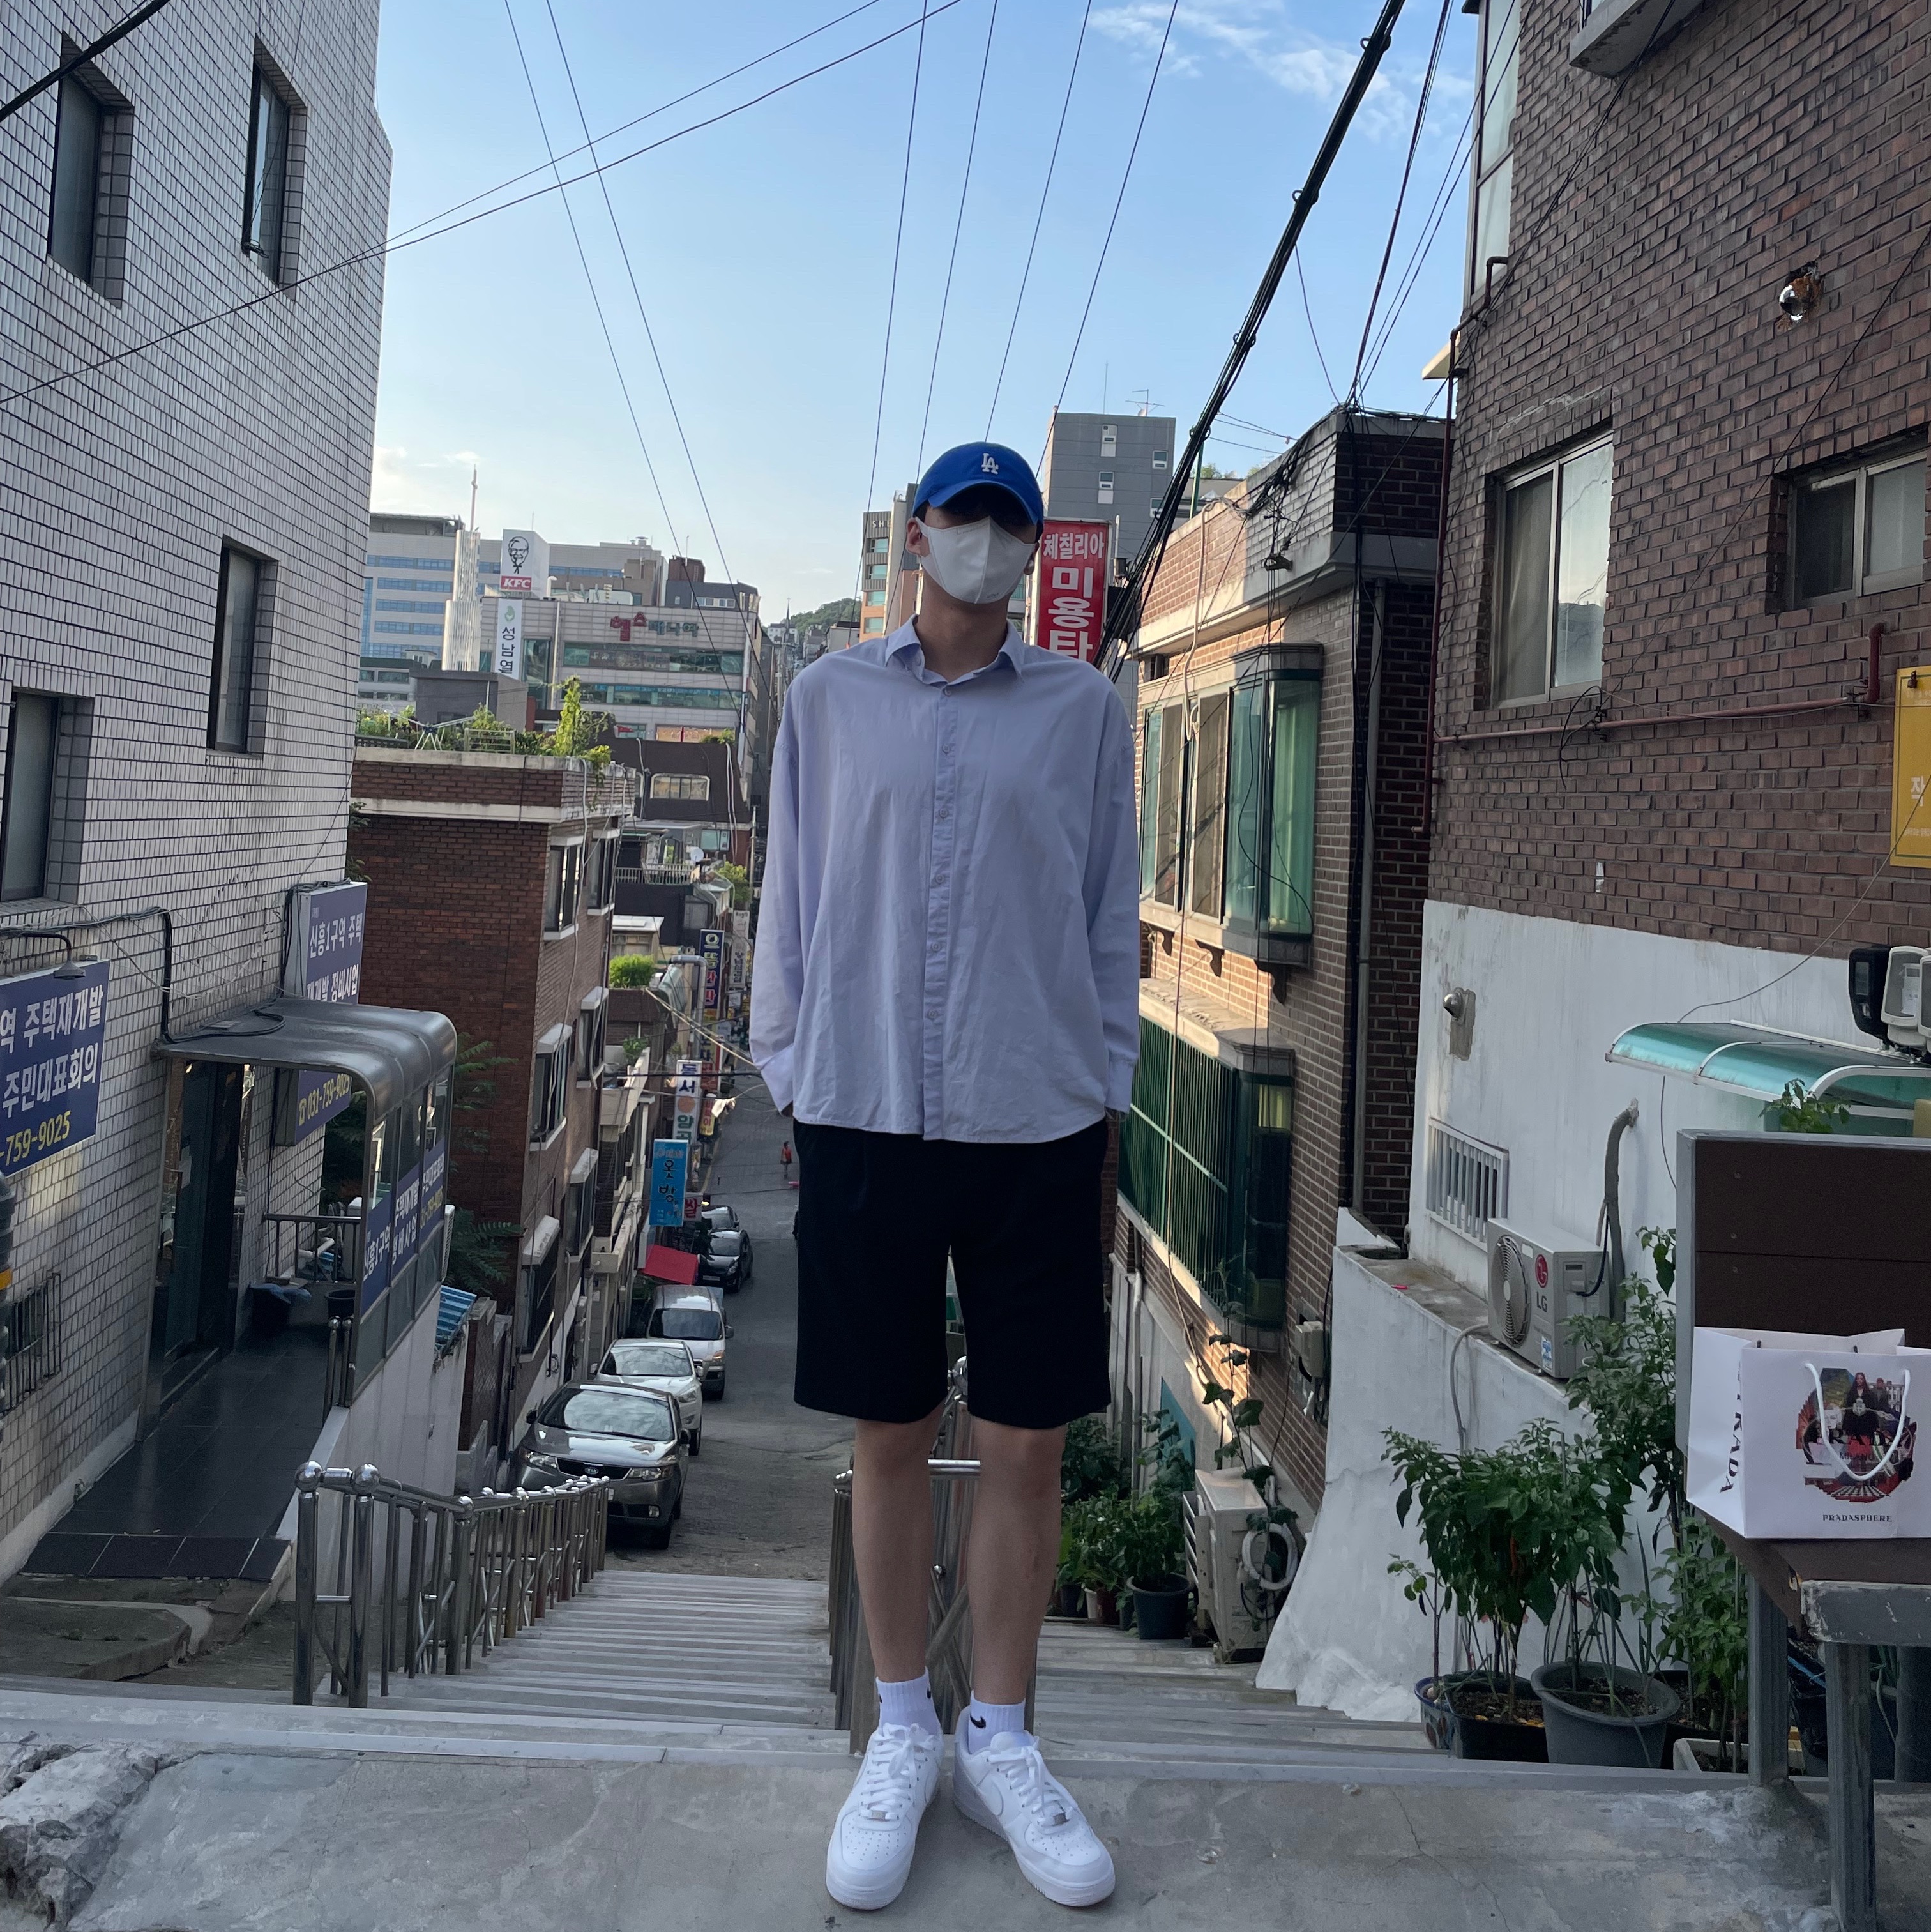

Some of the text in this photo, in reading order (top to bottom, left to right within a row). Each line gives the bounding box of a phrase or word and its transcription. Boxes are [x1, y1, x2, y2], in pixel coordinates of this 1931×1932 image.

[981, 453, 999, 475] LA
[1043, 532, 1105, 560] 체칠리아
[503, 578, 531, 589] KFC
[310, 913, 363, 958] 신흥1구역 주택
[331, 964, 359, 1003] 정비사업
[24, 984, 103, 1048] 주택재개발
[3, 1042, 98, 1118] 주민대표회의
[1536, 1291, 1547, 1312] LG
[1822, 1514, 1893, 1523] PRADASPHERE
